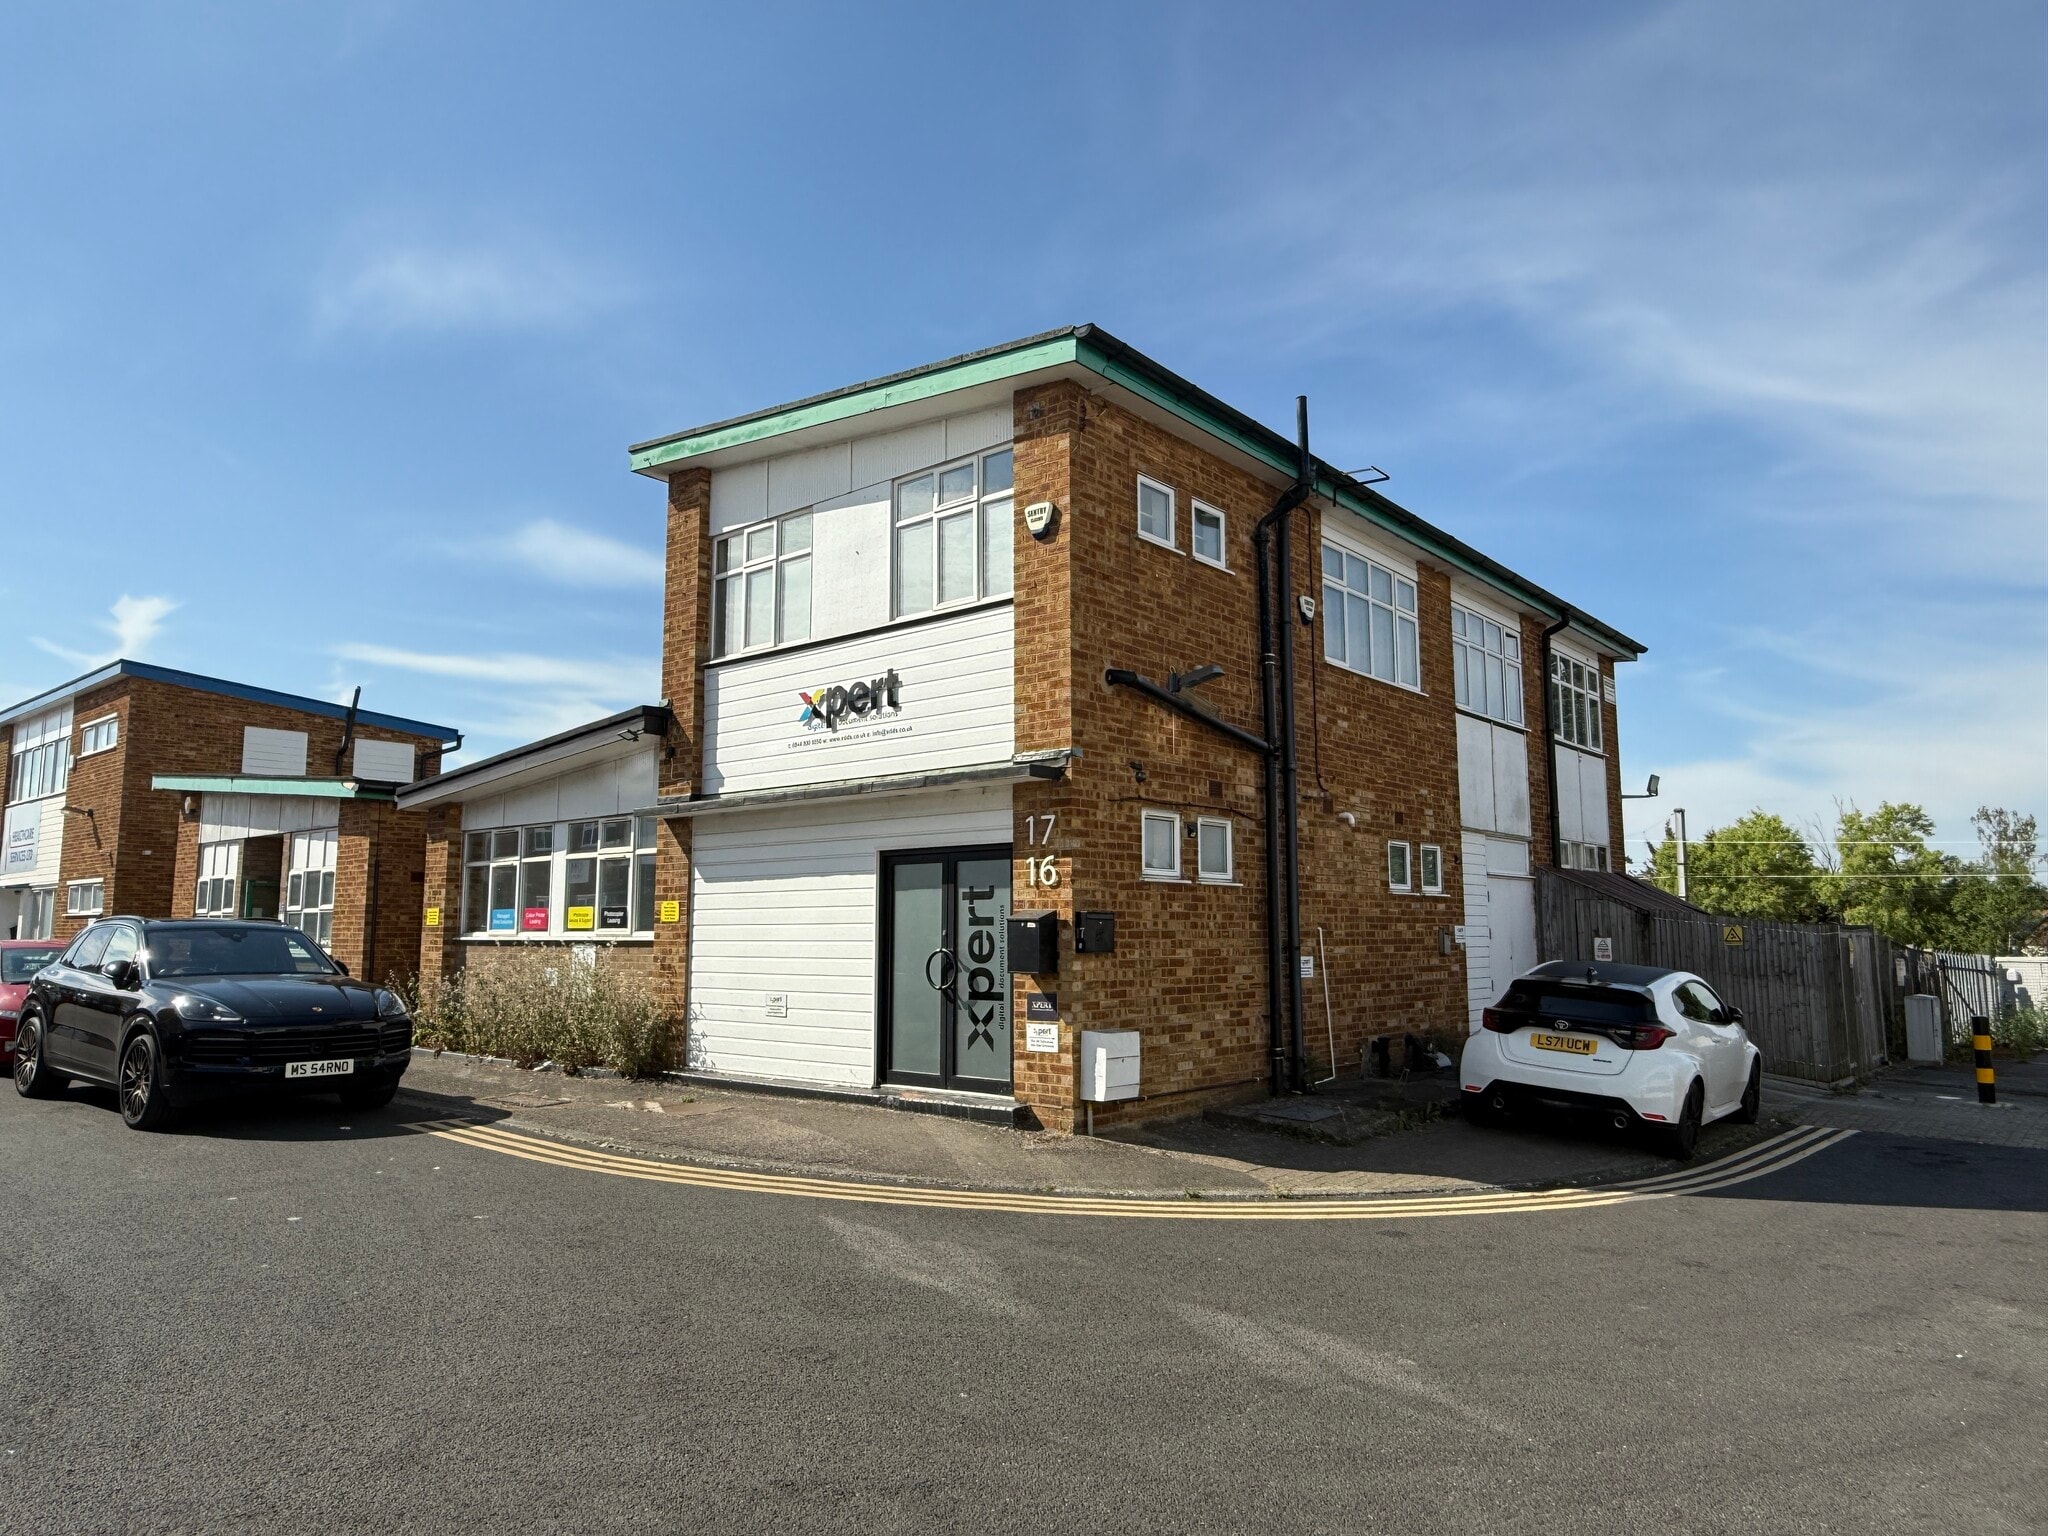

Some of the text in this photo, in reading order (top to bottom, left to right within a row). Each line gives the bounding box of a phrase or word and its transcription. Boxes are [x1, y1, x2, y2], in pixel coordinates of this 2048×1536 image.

[1028, 507, 1046, 517] SENTRY
[799, 668, 901, 730] xpert
[1025, 815, 1055, 845] 17
[1026, 855, 1056, 886] 16
[962, 885, 1004, 1052] xpert
[1031, 1001, 1052, 1009] XPERT
[1537, 1034, 1590, 1051] LS71 UCW
[291, 1064, 307, 1075] MS
